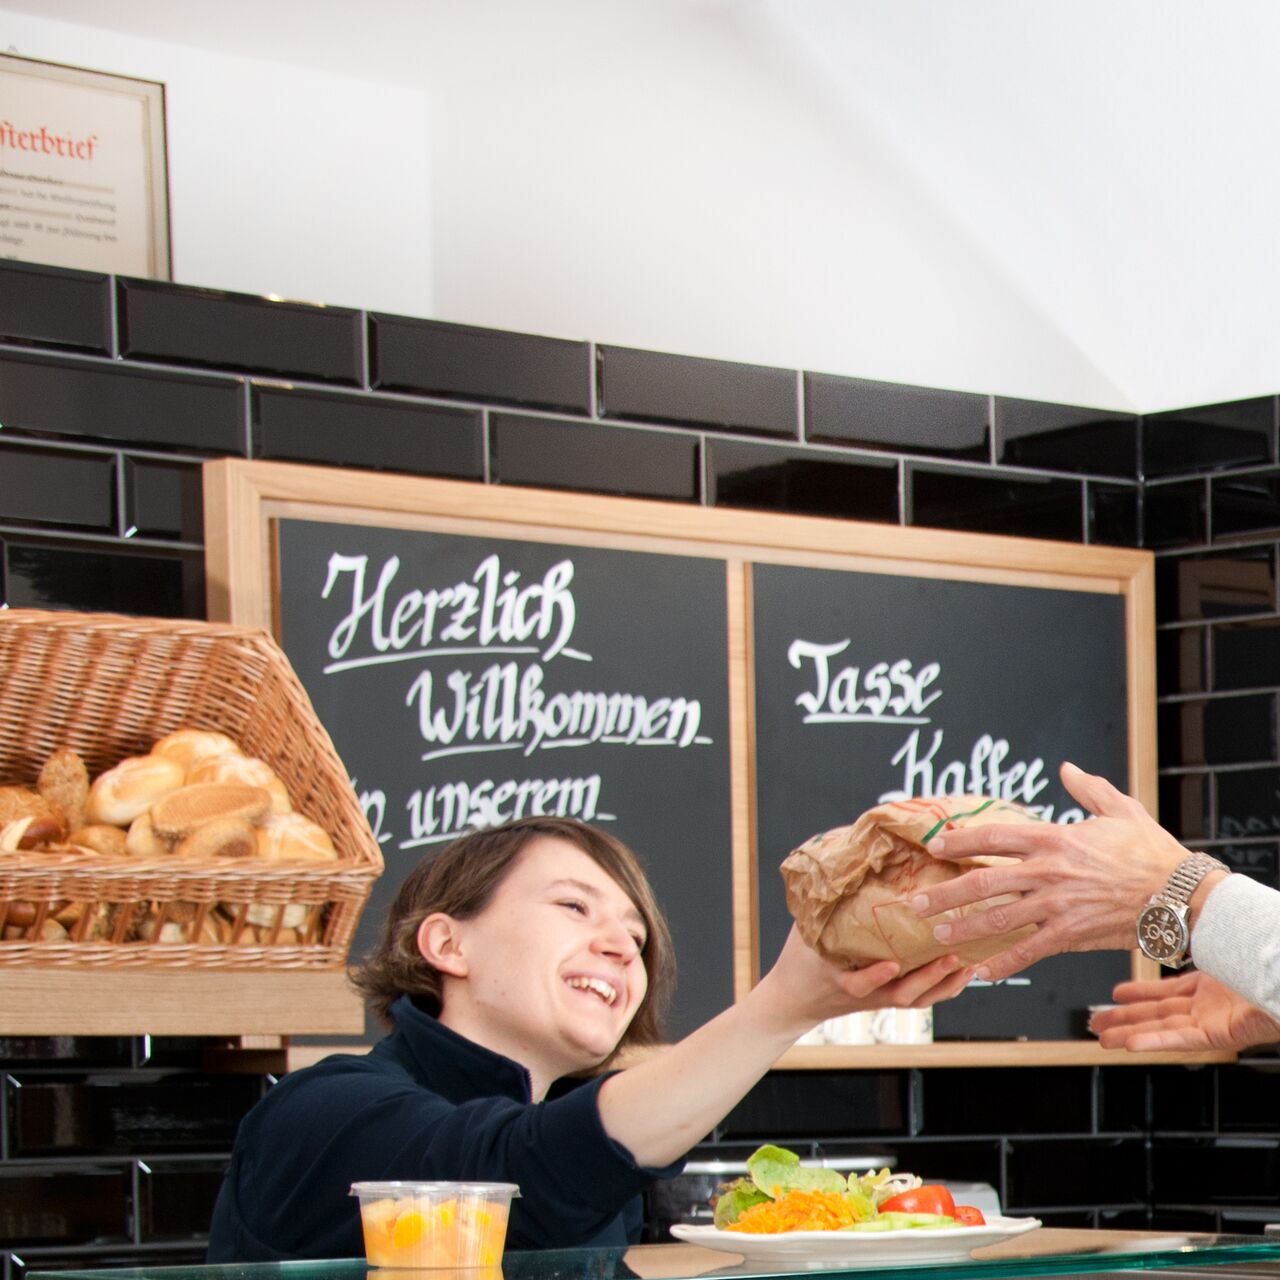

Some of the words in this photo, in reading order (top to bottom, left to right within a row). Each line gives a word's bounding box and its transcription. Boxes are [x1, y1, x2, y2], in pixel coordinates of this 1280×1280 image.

[321, 552, 576, 662] Herzlich
[405, 661, 701, 756] Willkommen
[788, 638, 943, 716] Tasse
[878, 729, 1049, 803] Kaffee
[407, 774, 602, 838] unserem
